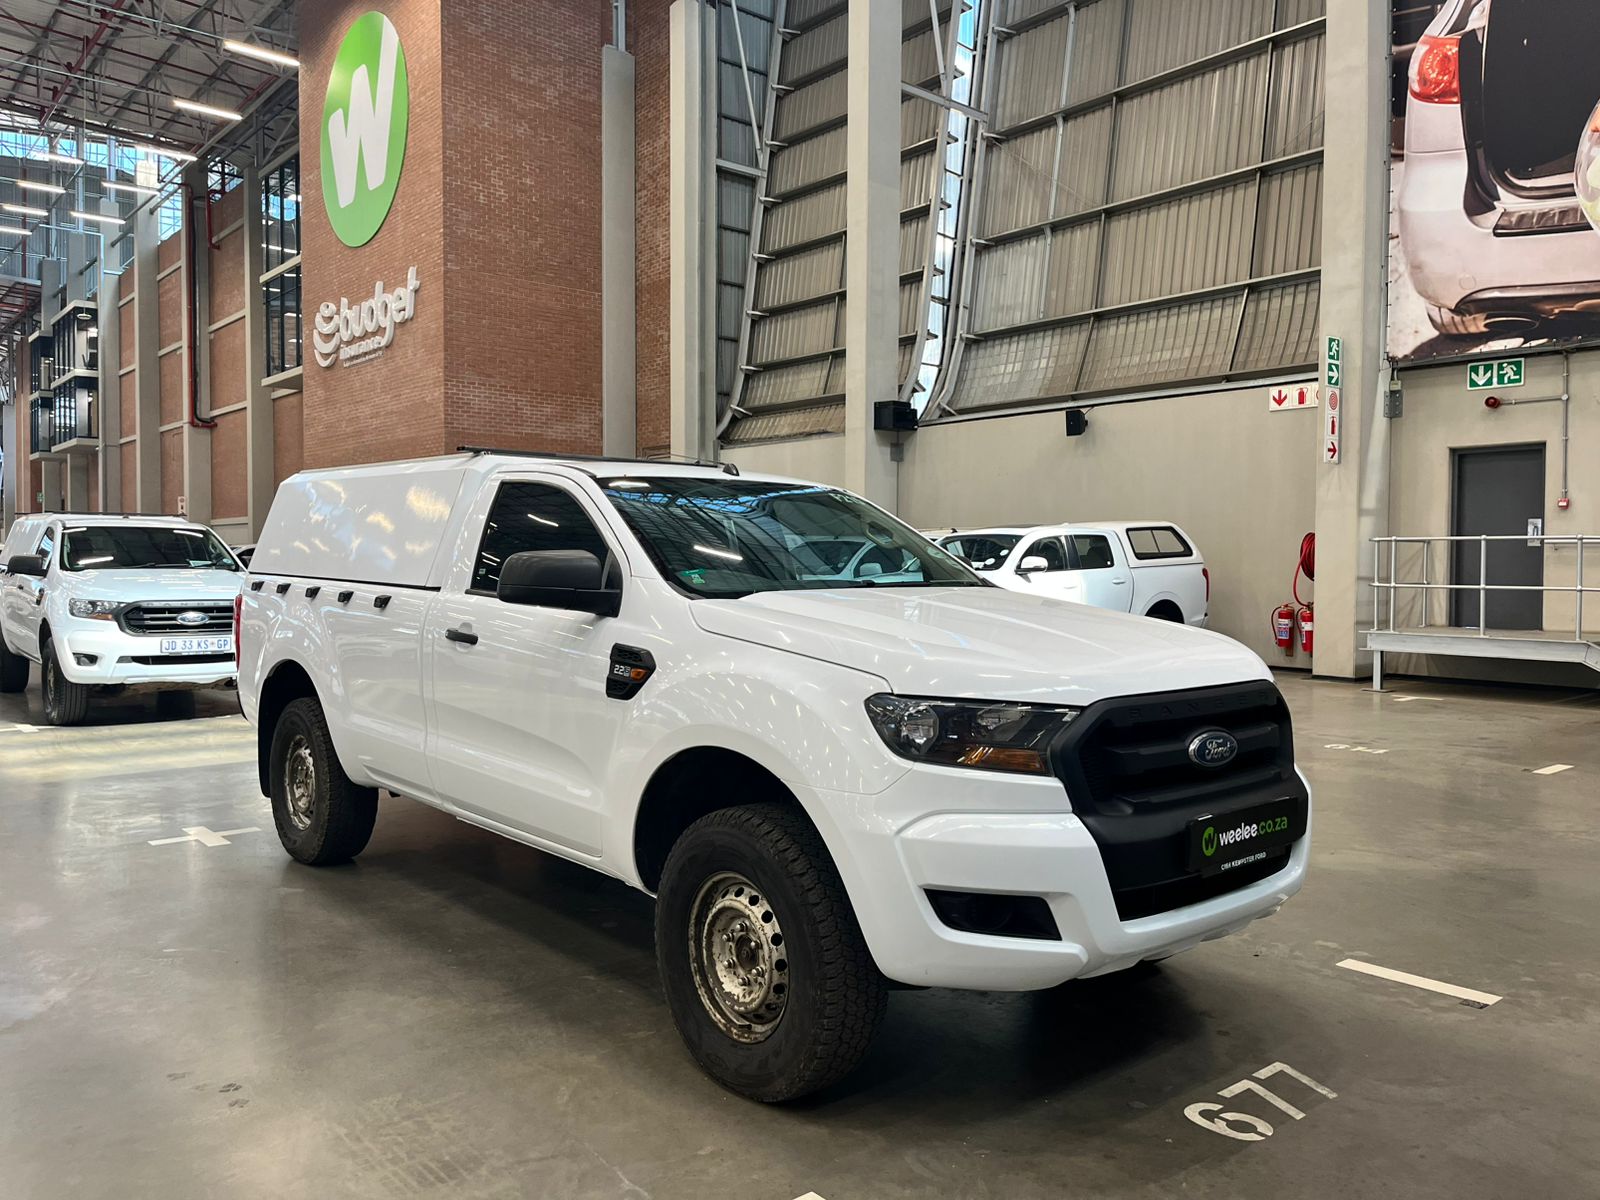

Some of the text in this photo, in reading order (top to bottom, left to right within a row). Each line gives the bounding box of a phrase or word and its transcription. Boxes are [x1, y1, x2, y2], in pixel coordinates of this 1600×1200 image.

[340, 265, 421, 348] budget
[165, 639, 229, 651] JD 33 KS GP
[1205, 739, 1231, 760] Ford
[1219, 816, 1288, 847] weelee.co.za
[1255, 851, 1267, 861] FORD
[1183, 1061, 1338, 1141] 677
